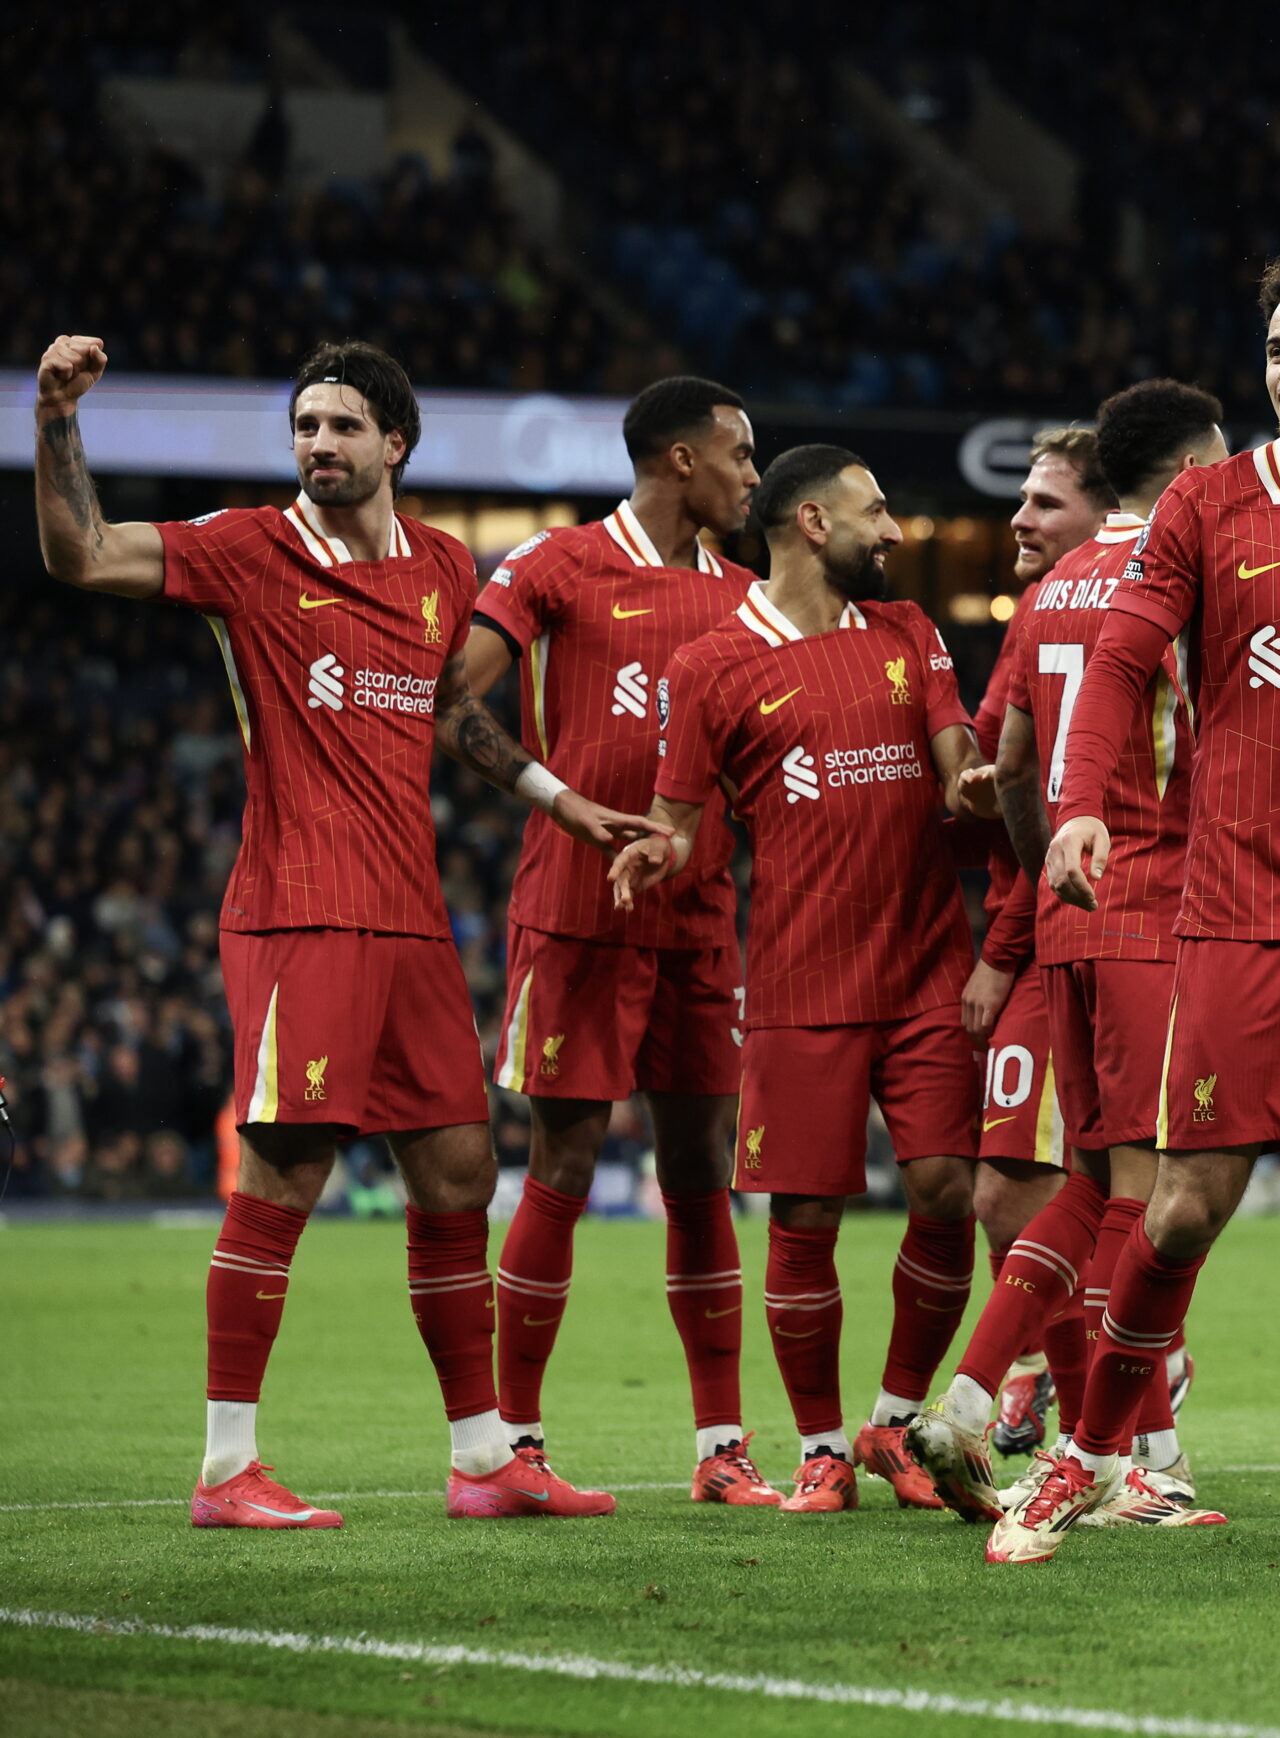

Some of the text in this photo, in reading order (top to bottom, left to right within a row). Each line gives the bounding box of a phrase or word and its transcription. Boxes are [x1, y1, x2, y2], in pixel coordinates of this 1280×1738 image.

[1034, 567, 1120, 611] LUIS DÍAZ
[354, 668, 438, 695] standard
[353, 688, 435, 713] chartered
[1039, 643, 1085, 803] 7
[825, 741, 915, 769] standard
[828, 760, 922, 788] chartered
[1005, 1274, 1036, 1294] LFC
[1085, 1329, 1100, 1341] FC
[1119, 1363, 1151, 1375] LFC
